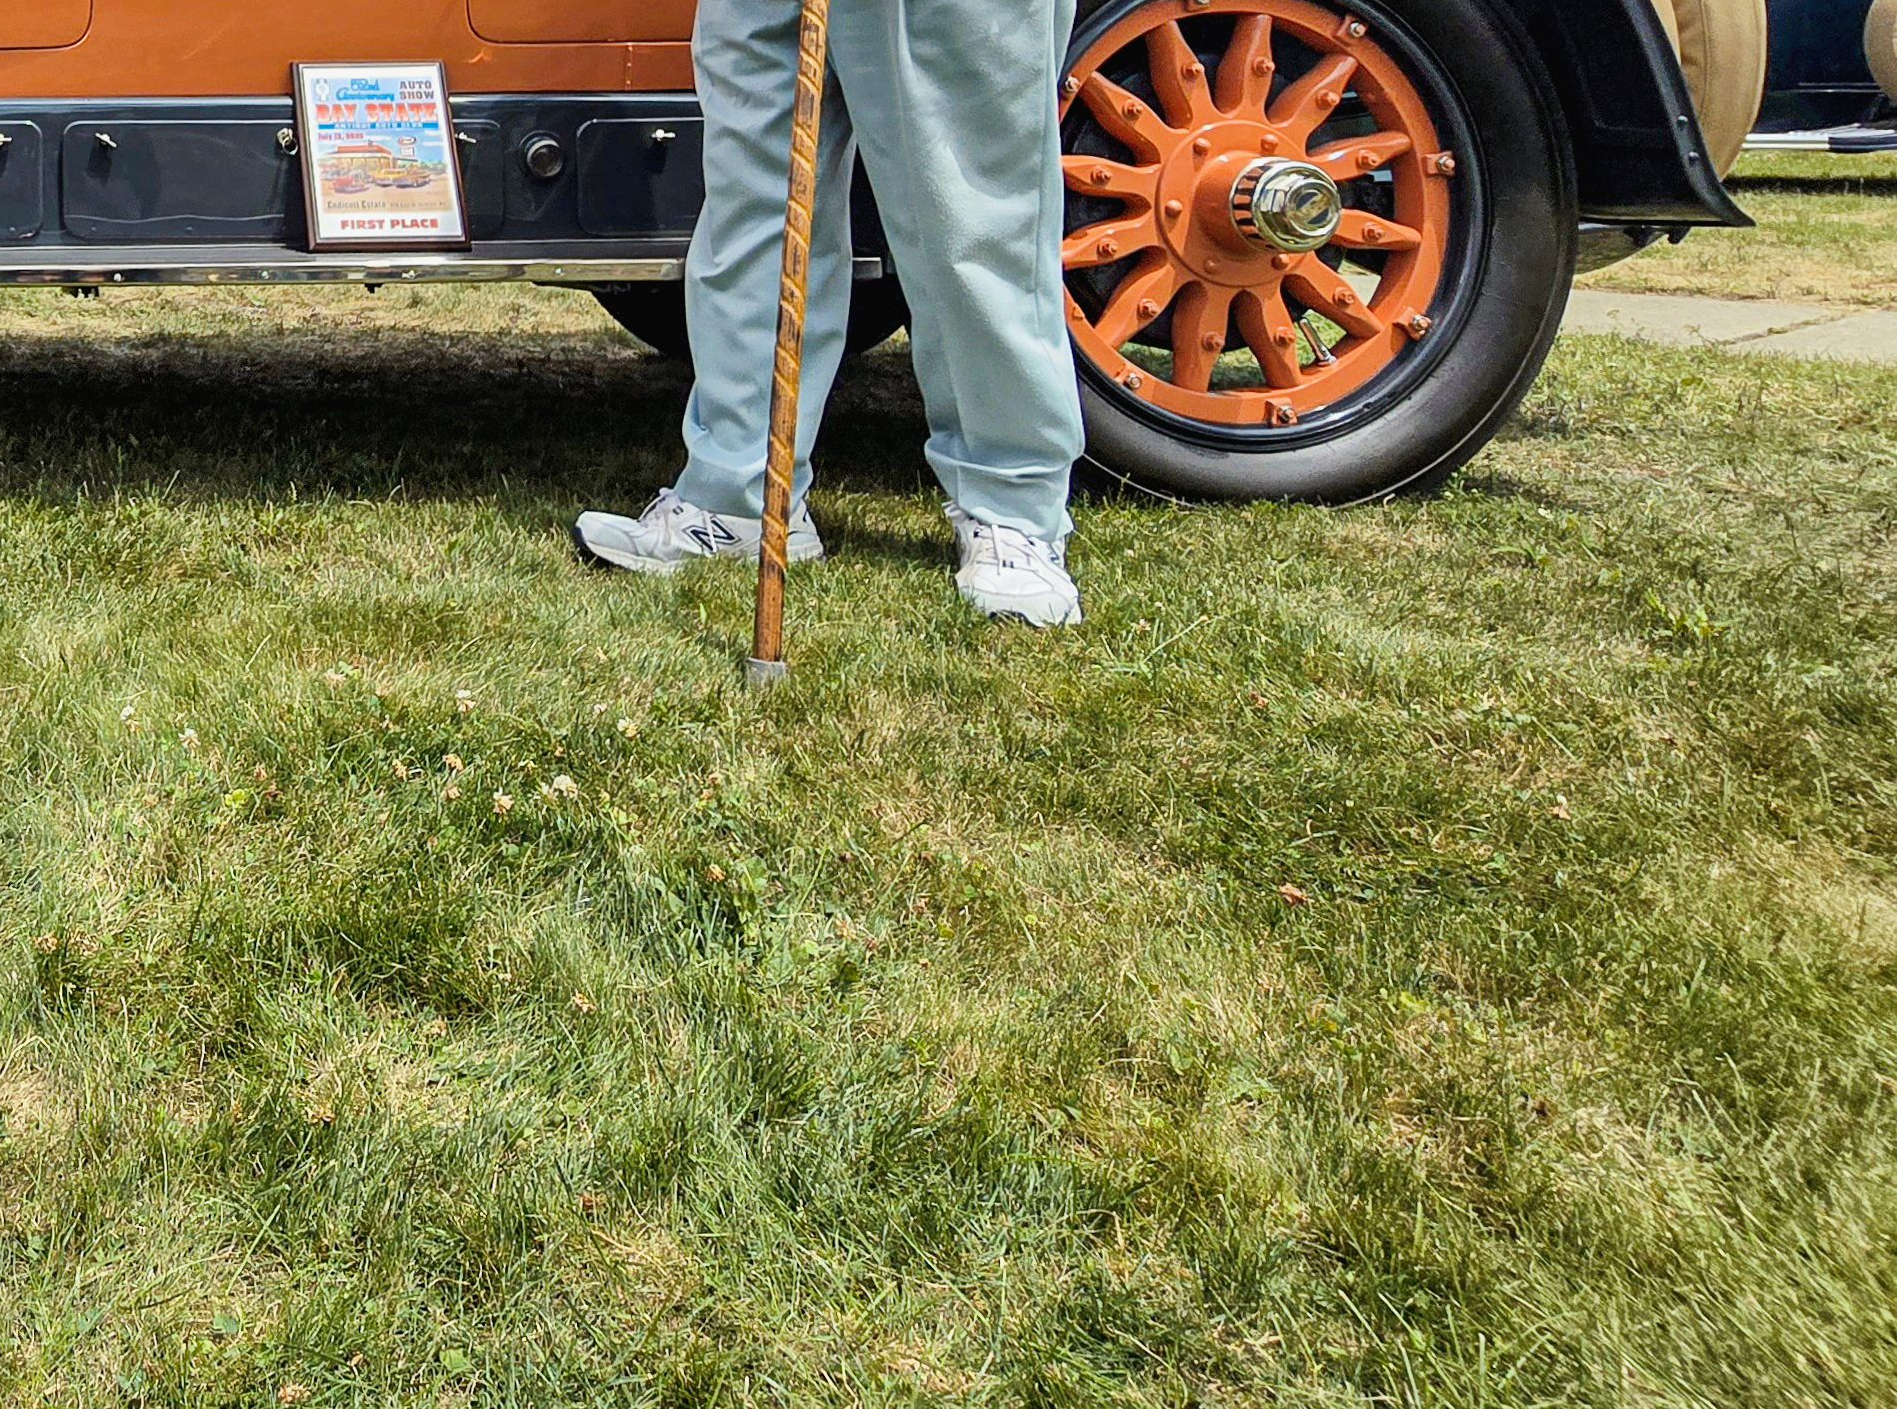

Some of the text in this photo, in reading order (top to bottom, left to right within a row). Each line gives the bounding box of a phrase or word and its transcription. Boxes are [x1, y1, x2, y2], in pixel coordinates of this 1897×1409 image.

[400, 80, 432, 89] AUTO
[400, 90, 434, 100] SHOW
[315, 103, 438, 122] BAY STATE
[341, 218, 439, 230] FIRST PLACE
